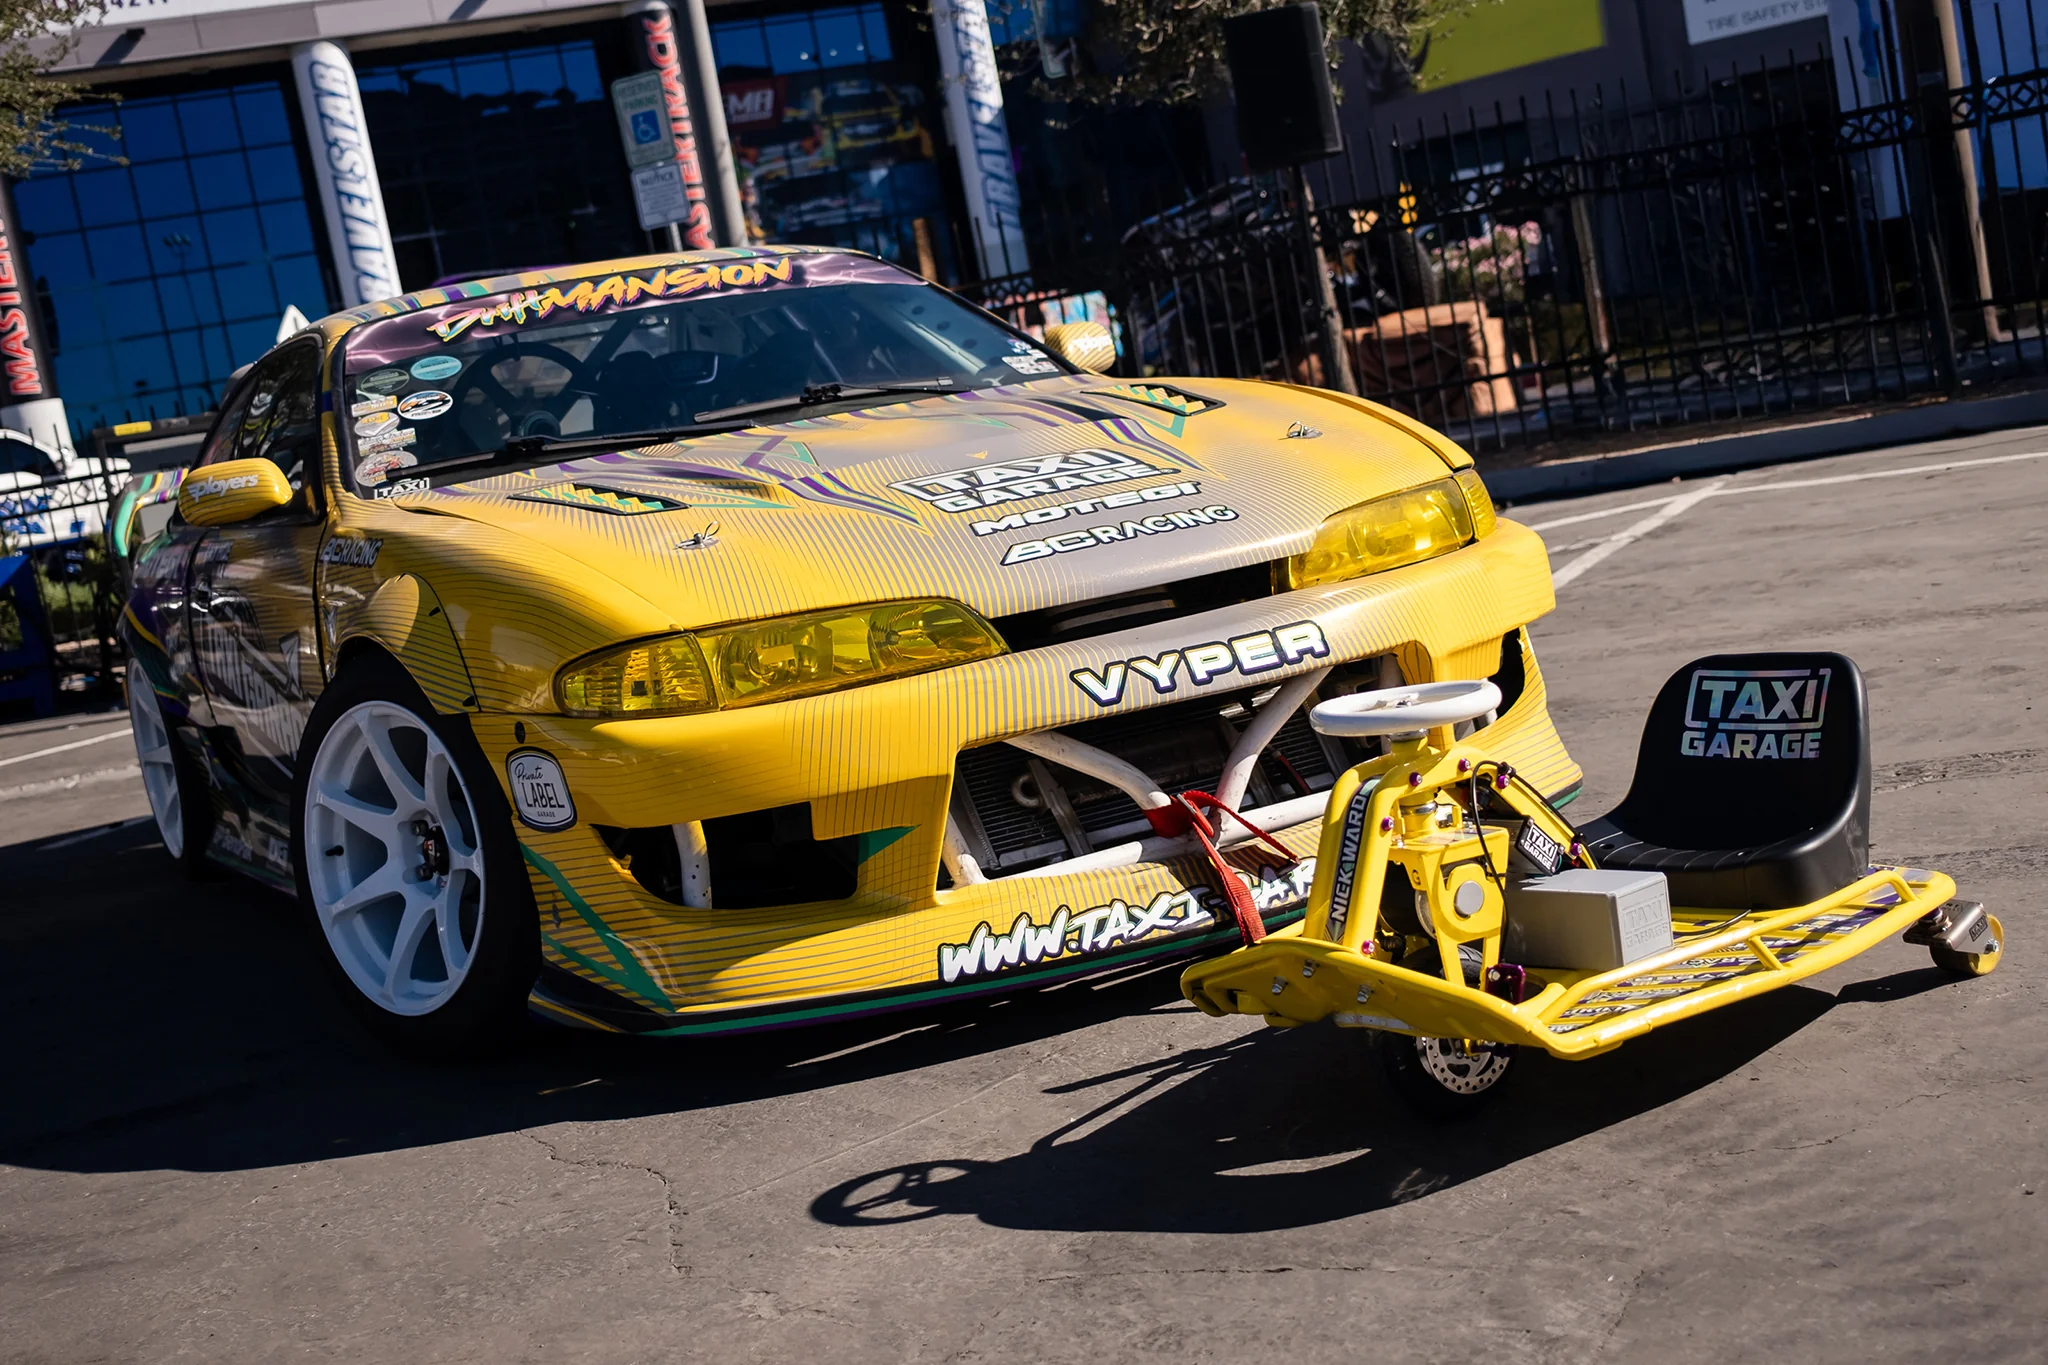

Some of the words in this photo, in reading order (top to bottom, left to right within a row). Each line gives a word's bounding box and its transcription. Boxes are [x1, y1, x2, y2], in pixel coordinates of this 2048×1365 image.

[535, 256, 794, 320] MANSION
[910, 450, 1120, 494] TAXI
[186, 475, 260, 503] players
[376, 478, 429, 498] TAXI
[932, 464, 1162, 513] GARAGE
[969, 481, 1201, 537] MOTEGI
[1070, 620, 1330, 707] VYPER
[1700, 680, 1819, 720] TAXI
[1680, 730, 1823, 760] GARAGE
[514, 762, 544, 784] Private
[521, 782, 566, 808] LABEL
[1342, 795, 1369, 863] WARD
[1529, 828, 1557, 858] TAXI
[1523, 840, 1554, 871] GARAGE
[1624, 899, 1666, 928] TAXI
